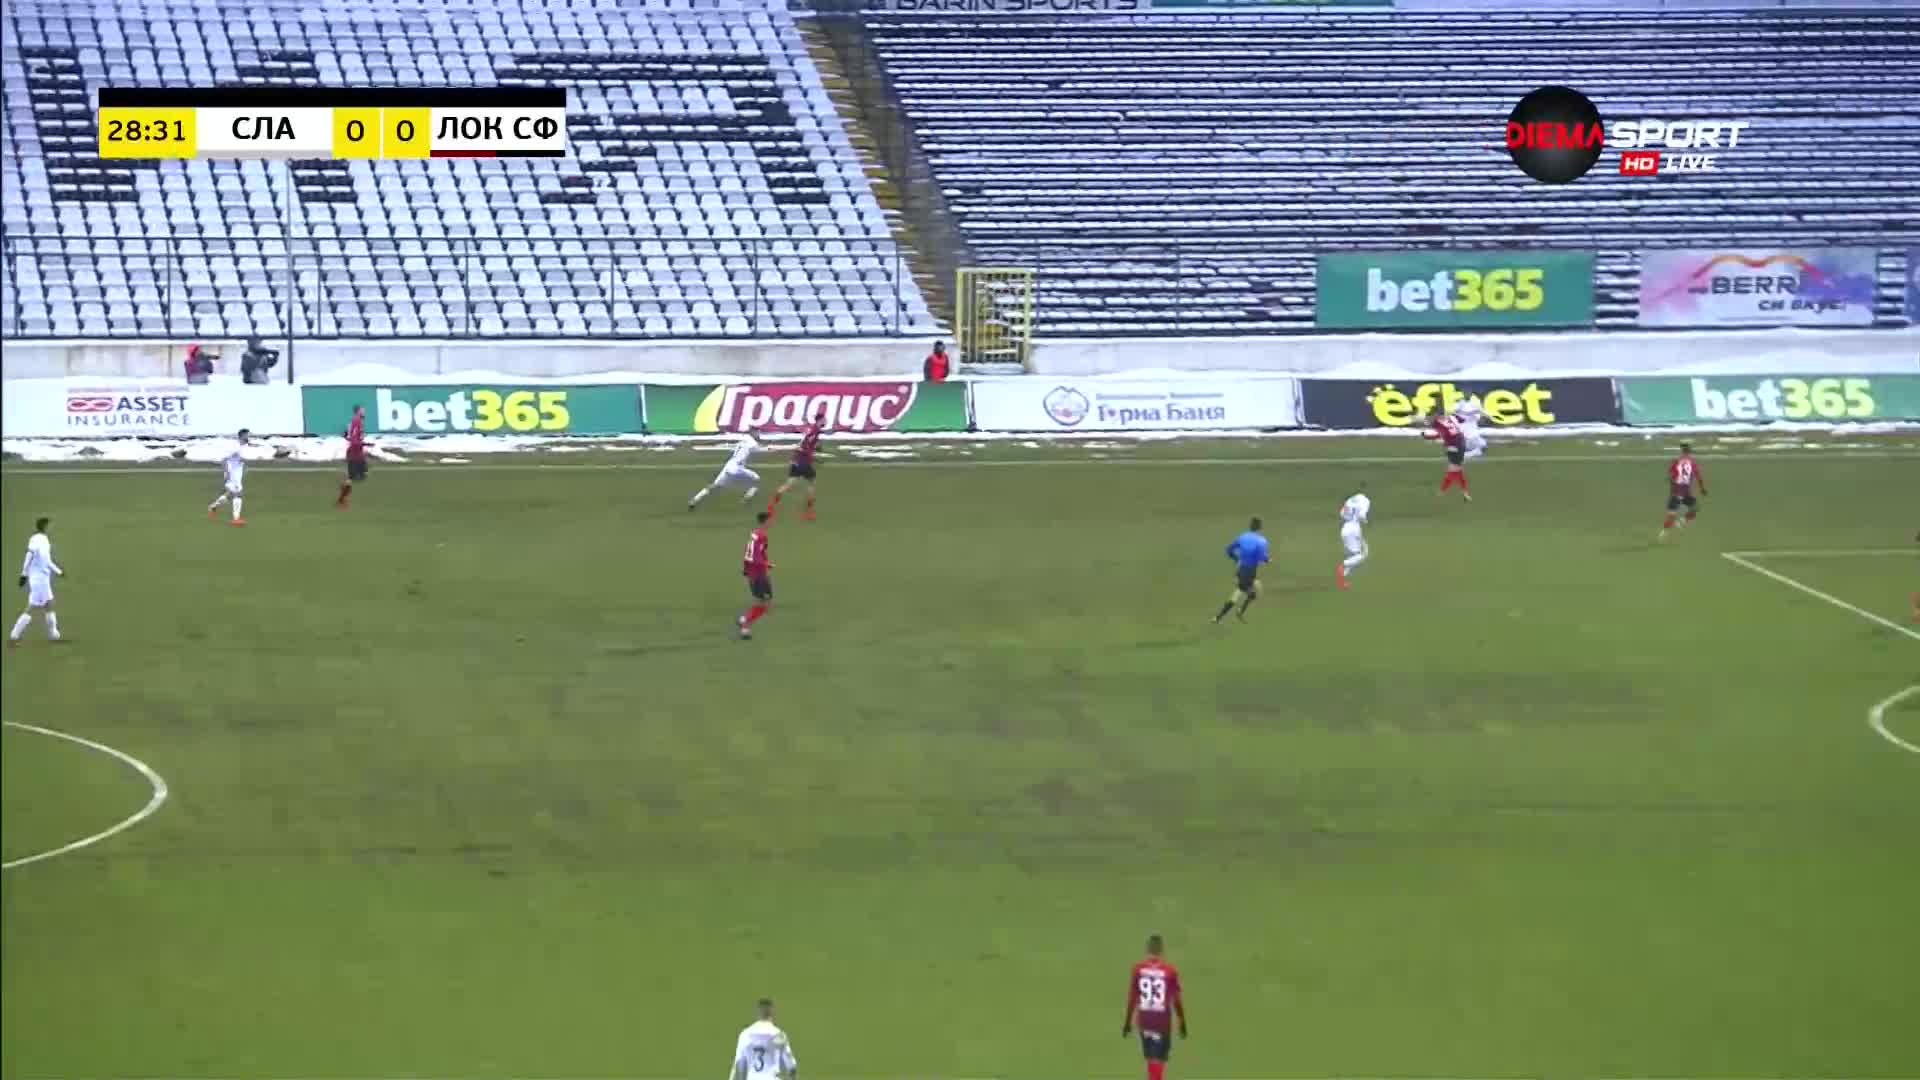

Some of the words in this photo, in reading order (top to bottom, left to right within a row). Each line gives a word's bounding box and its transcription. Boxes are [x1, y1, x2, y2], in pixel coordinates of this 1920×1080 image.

[1366, 267, 1544, 312] bet365
[116, 396, 189, 412] ASSET
[376, 388, 569, 432] bet365
[717, 384, 901, 432] Градус
[1166, 402, 1225, 420] Баня
[1691, 376, 1875, 419] bet365
[67, 414, 191, 426] INSURANCE
[1138, 976, 1167, 1011] 93
[752, 1047, 766, 1072] 3
